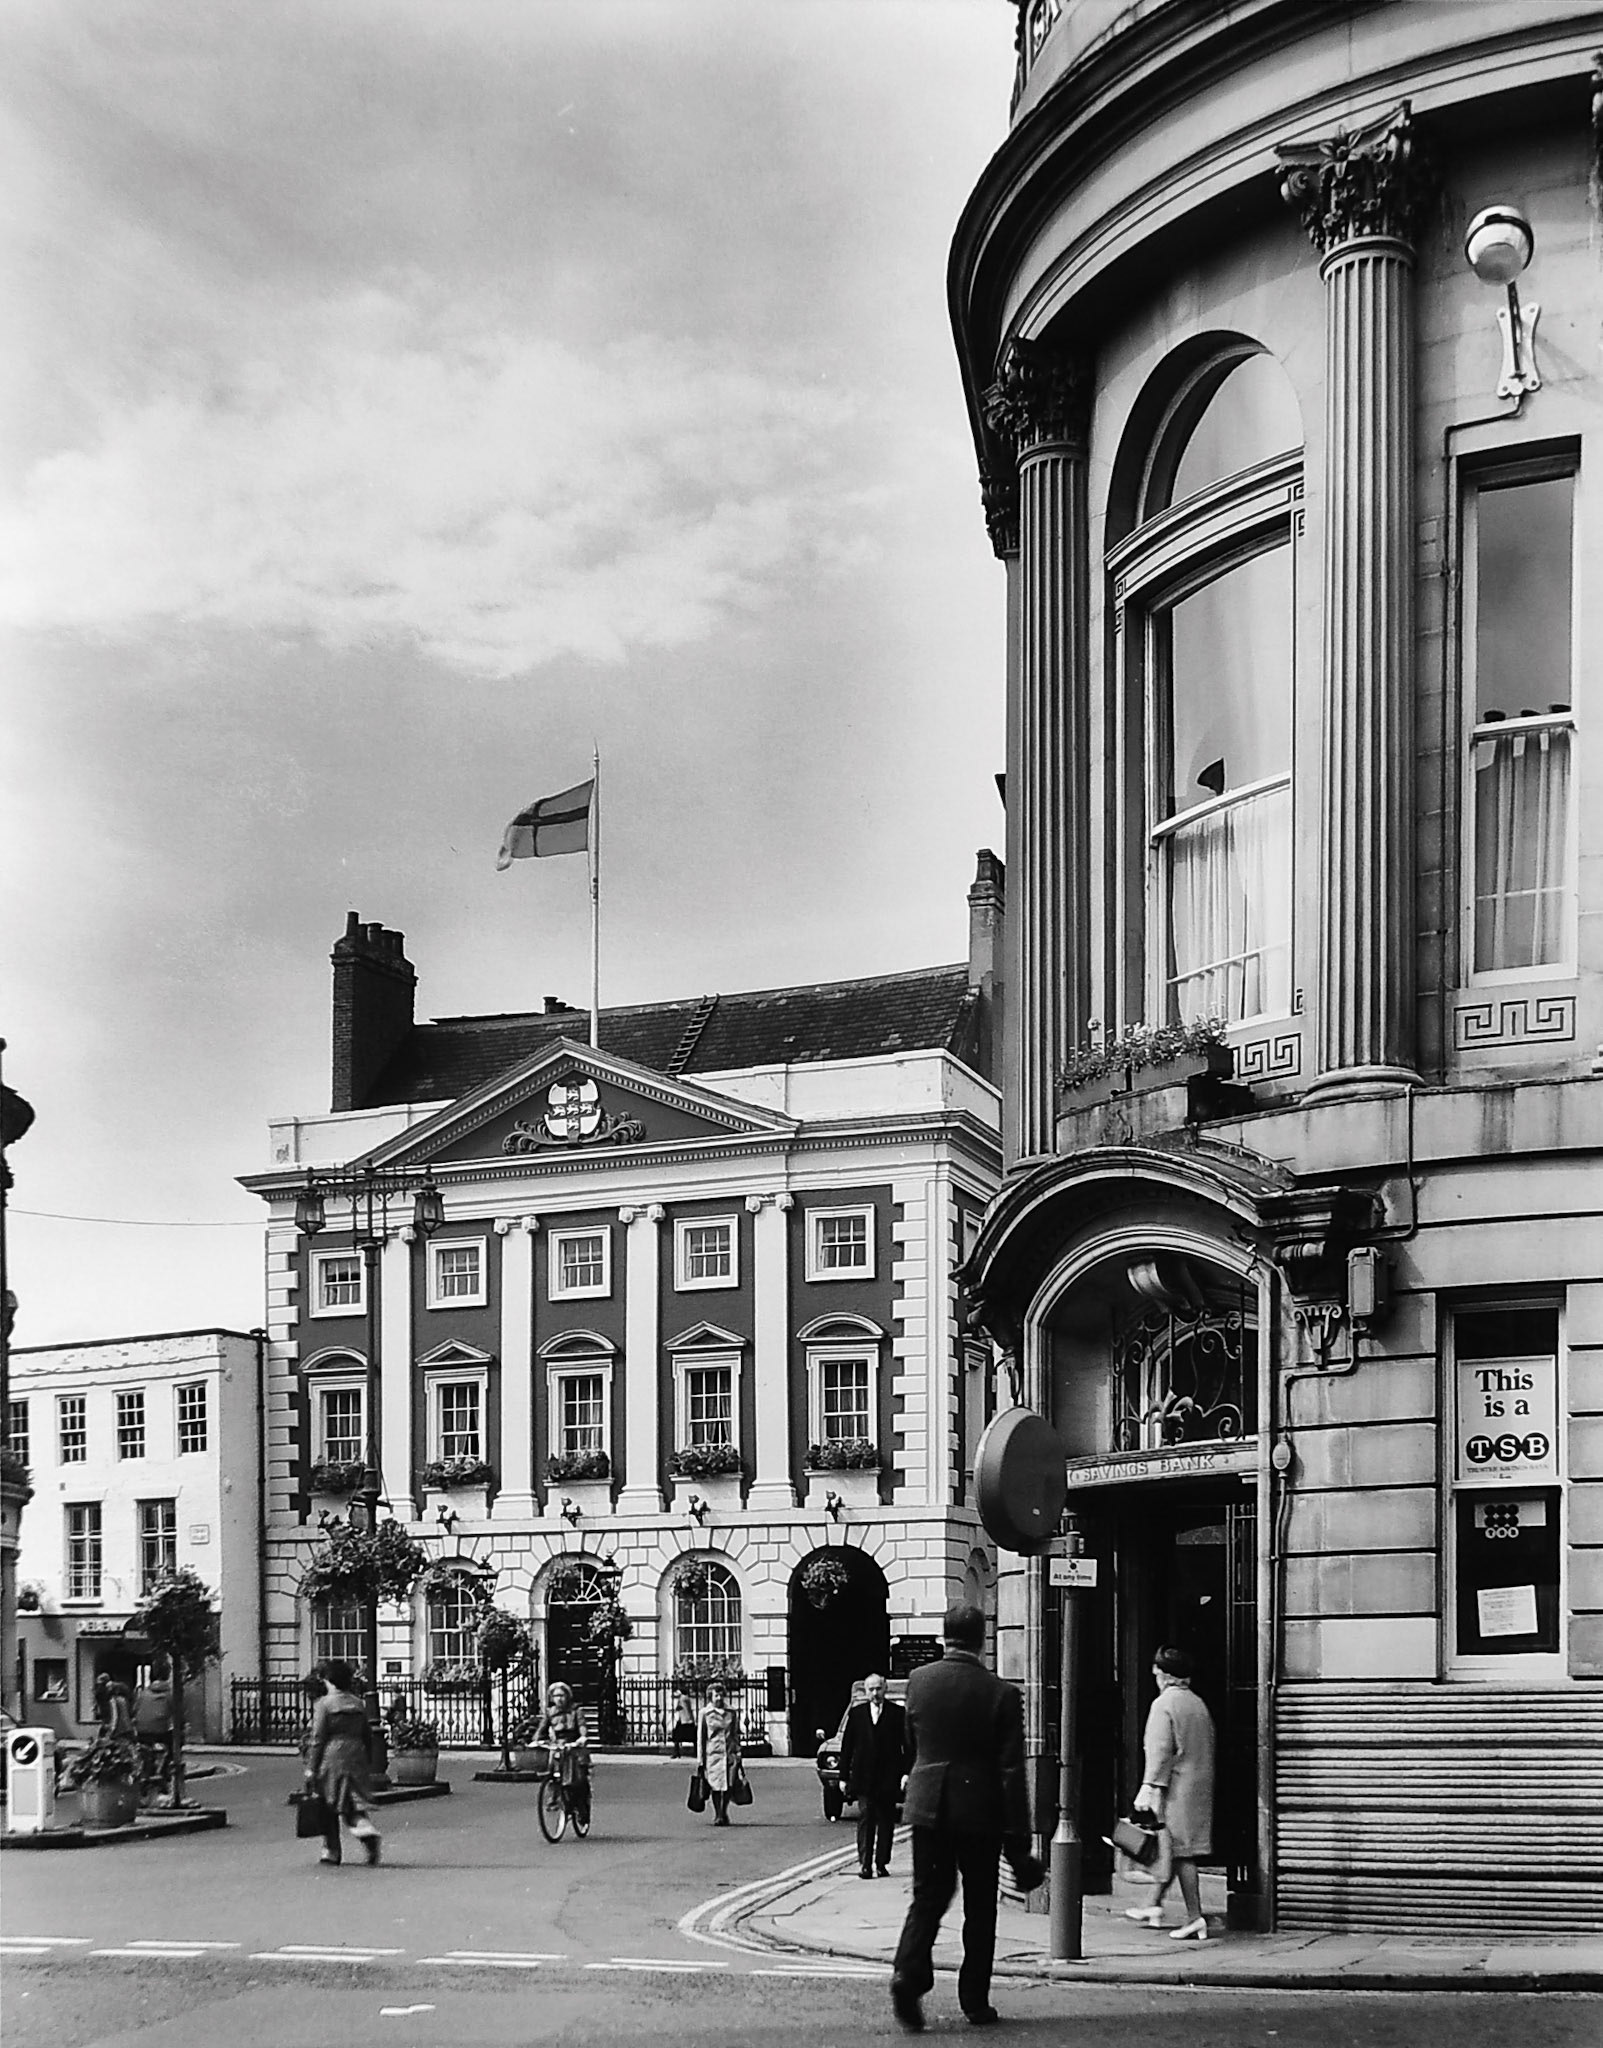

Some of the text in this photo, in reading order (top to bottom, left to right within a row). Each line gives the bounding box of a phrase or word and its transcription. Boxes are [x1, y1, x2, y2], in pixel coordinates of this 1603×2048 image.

[1475, 1368, 1534, 1392] This
[1484, 1395, 1530, 1417] is a
[1469, 1435, 1547, 1460] TSB
[1083, 1454, 1215, 1483] SAVINGS BANK
